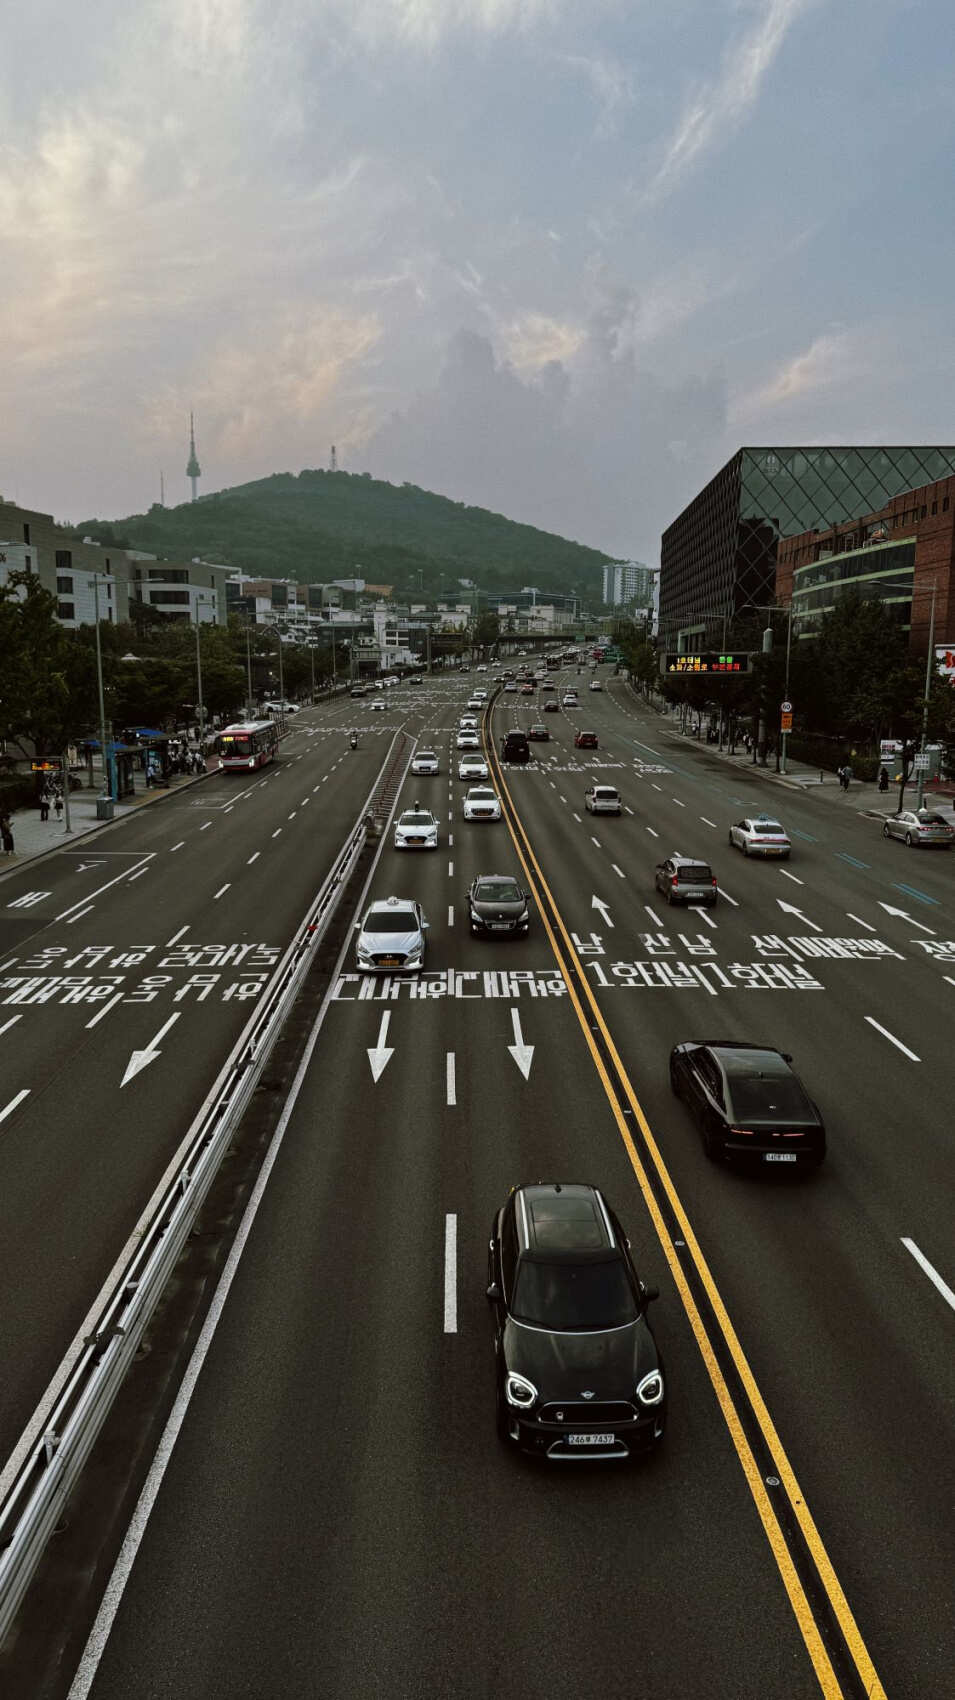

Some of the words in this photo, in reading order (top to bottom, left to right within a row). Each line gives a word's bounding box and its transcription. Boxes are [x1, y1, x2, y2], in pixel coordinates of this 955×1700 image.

[157, 943, 281, 967] 독서당로
[787, 936, 907, 961] 이태원역
[122, 973, 269, 1003] 한남동
[455, 970, 568, 998] 한남대교
[585, 961, 701, 988] 1호터널
[700, 962, 826, 990] 1호터널
